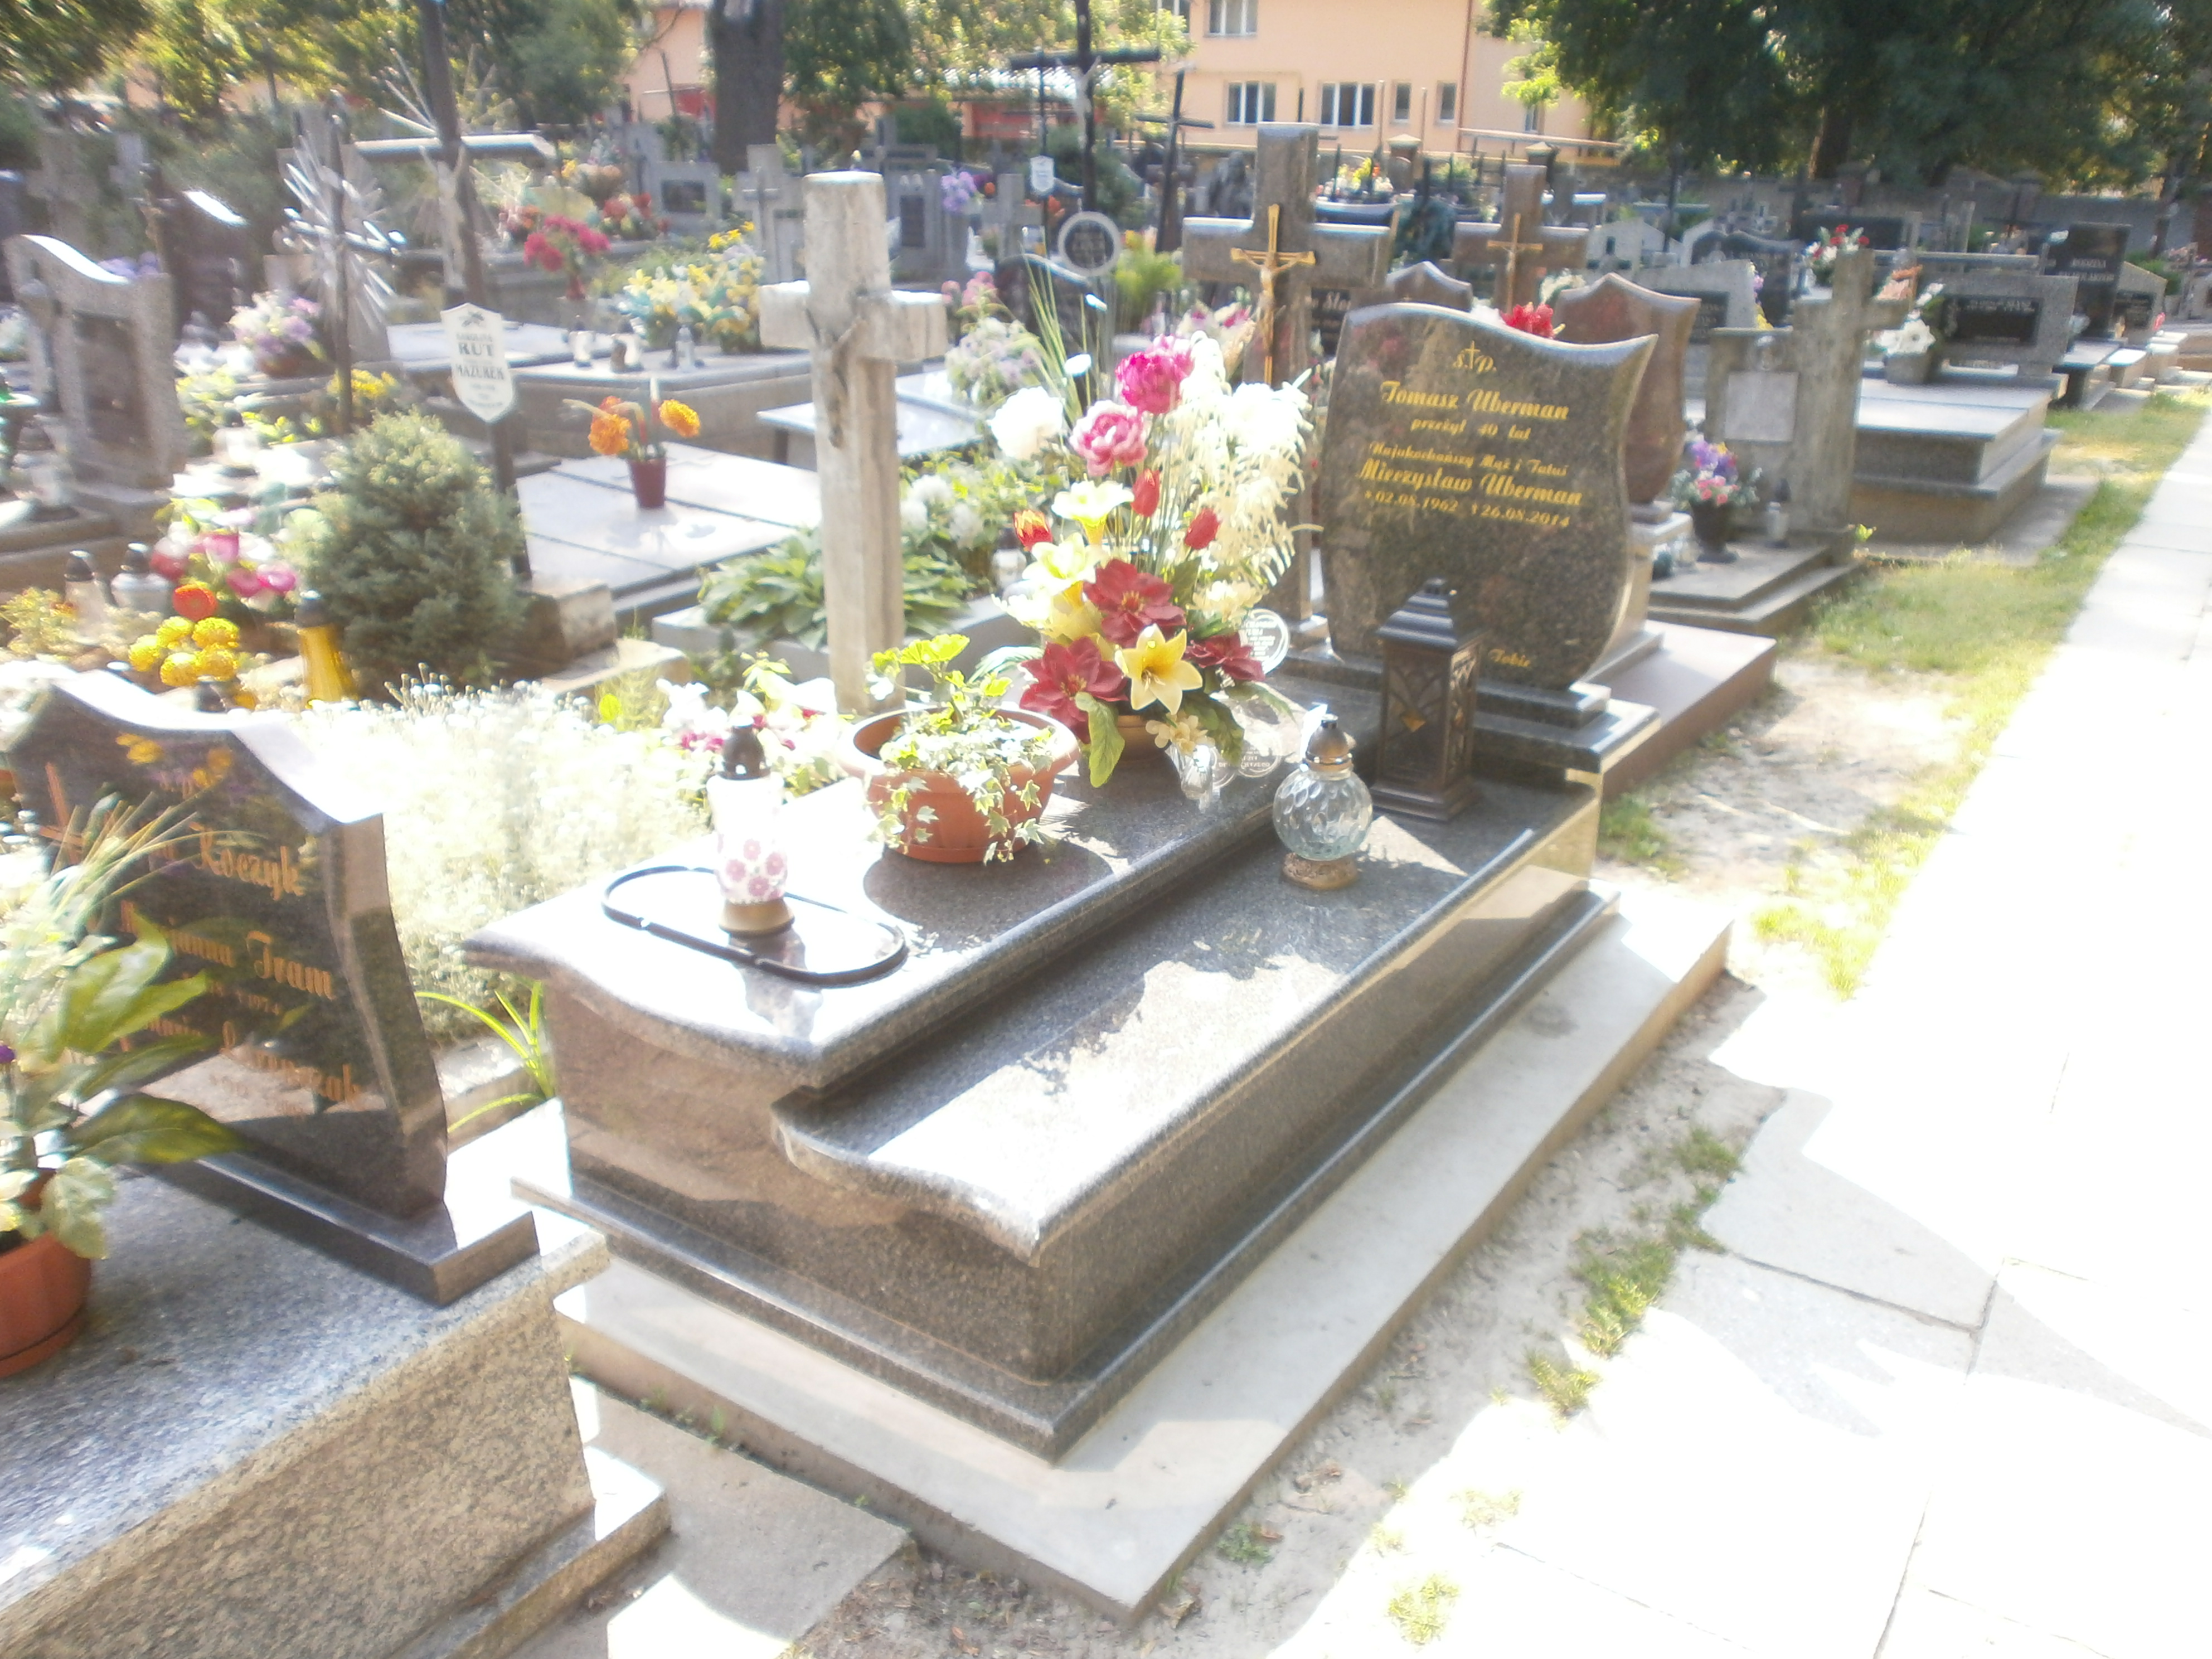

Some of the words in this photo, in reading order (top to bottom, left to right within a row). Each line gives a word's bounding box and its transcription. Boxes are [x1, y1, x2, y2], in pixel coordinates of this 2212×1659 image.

[458, 342, 493, 356] RUT
[1381, 380, 1459, 409] Tomasz
[1466, 389, 1570, 420] Uberman
[1507, 424, 1532, 440] lat
[1480, 473, 1583, 506] Uberman
